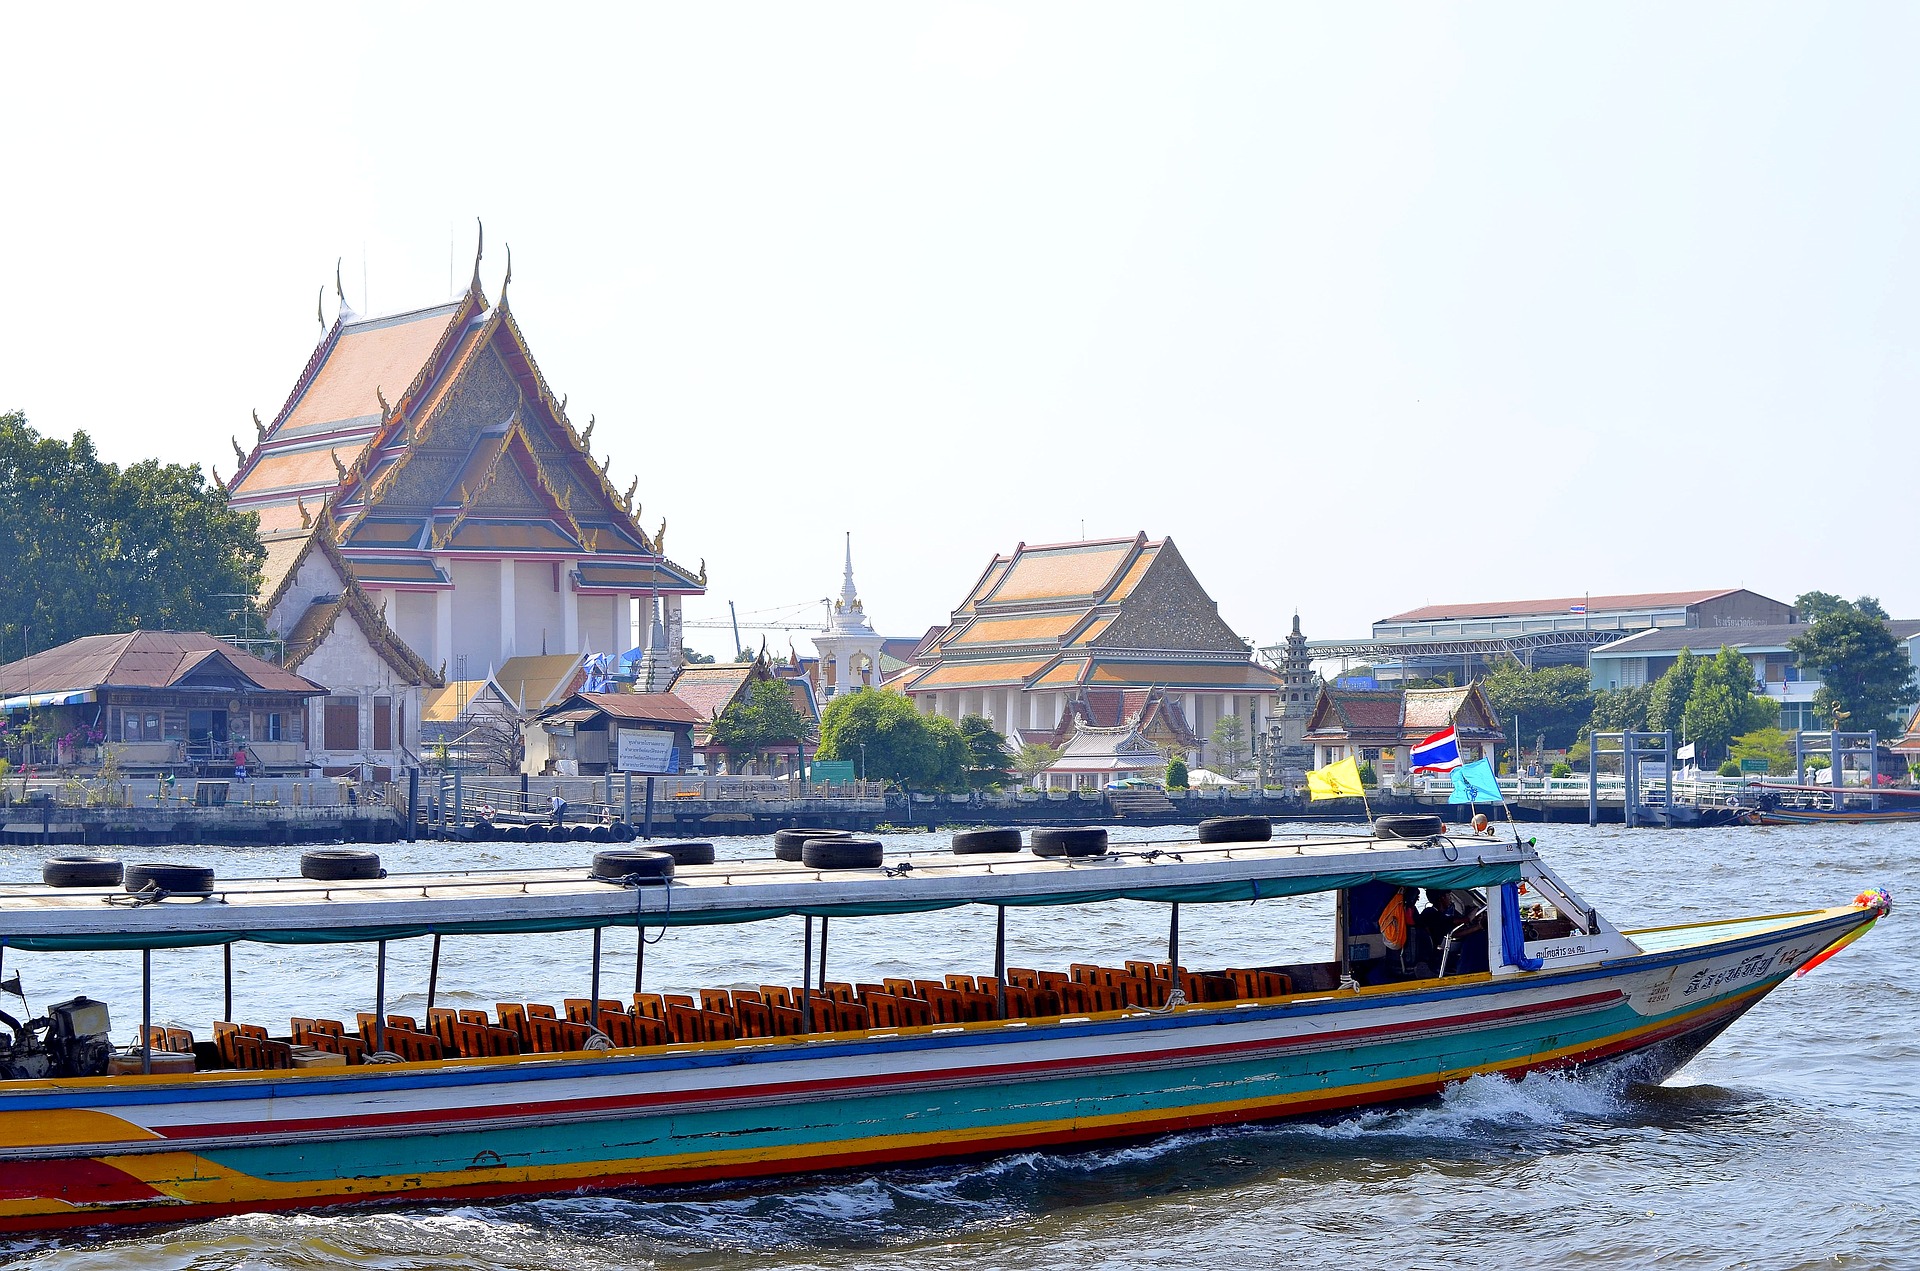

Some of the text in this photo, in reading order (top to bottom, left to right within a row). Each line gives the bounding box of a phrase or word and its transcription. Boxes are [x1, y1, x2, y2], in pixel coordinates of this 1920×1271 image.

[1506, 844, 1514, 852] 12
[1567, 947, 1576, 955] 24
[1576, 945, 1586, 953] คน
